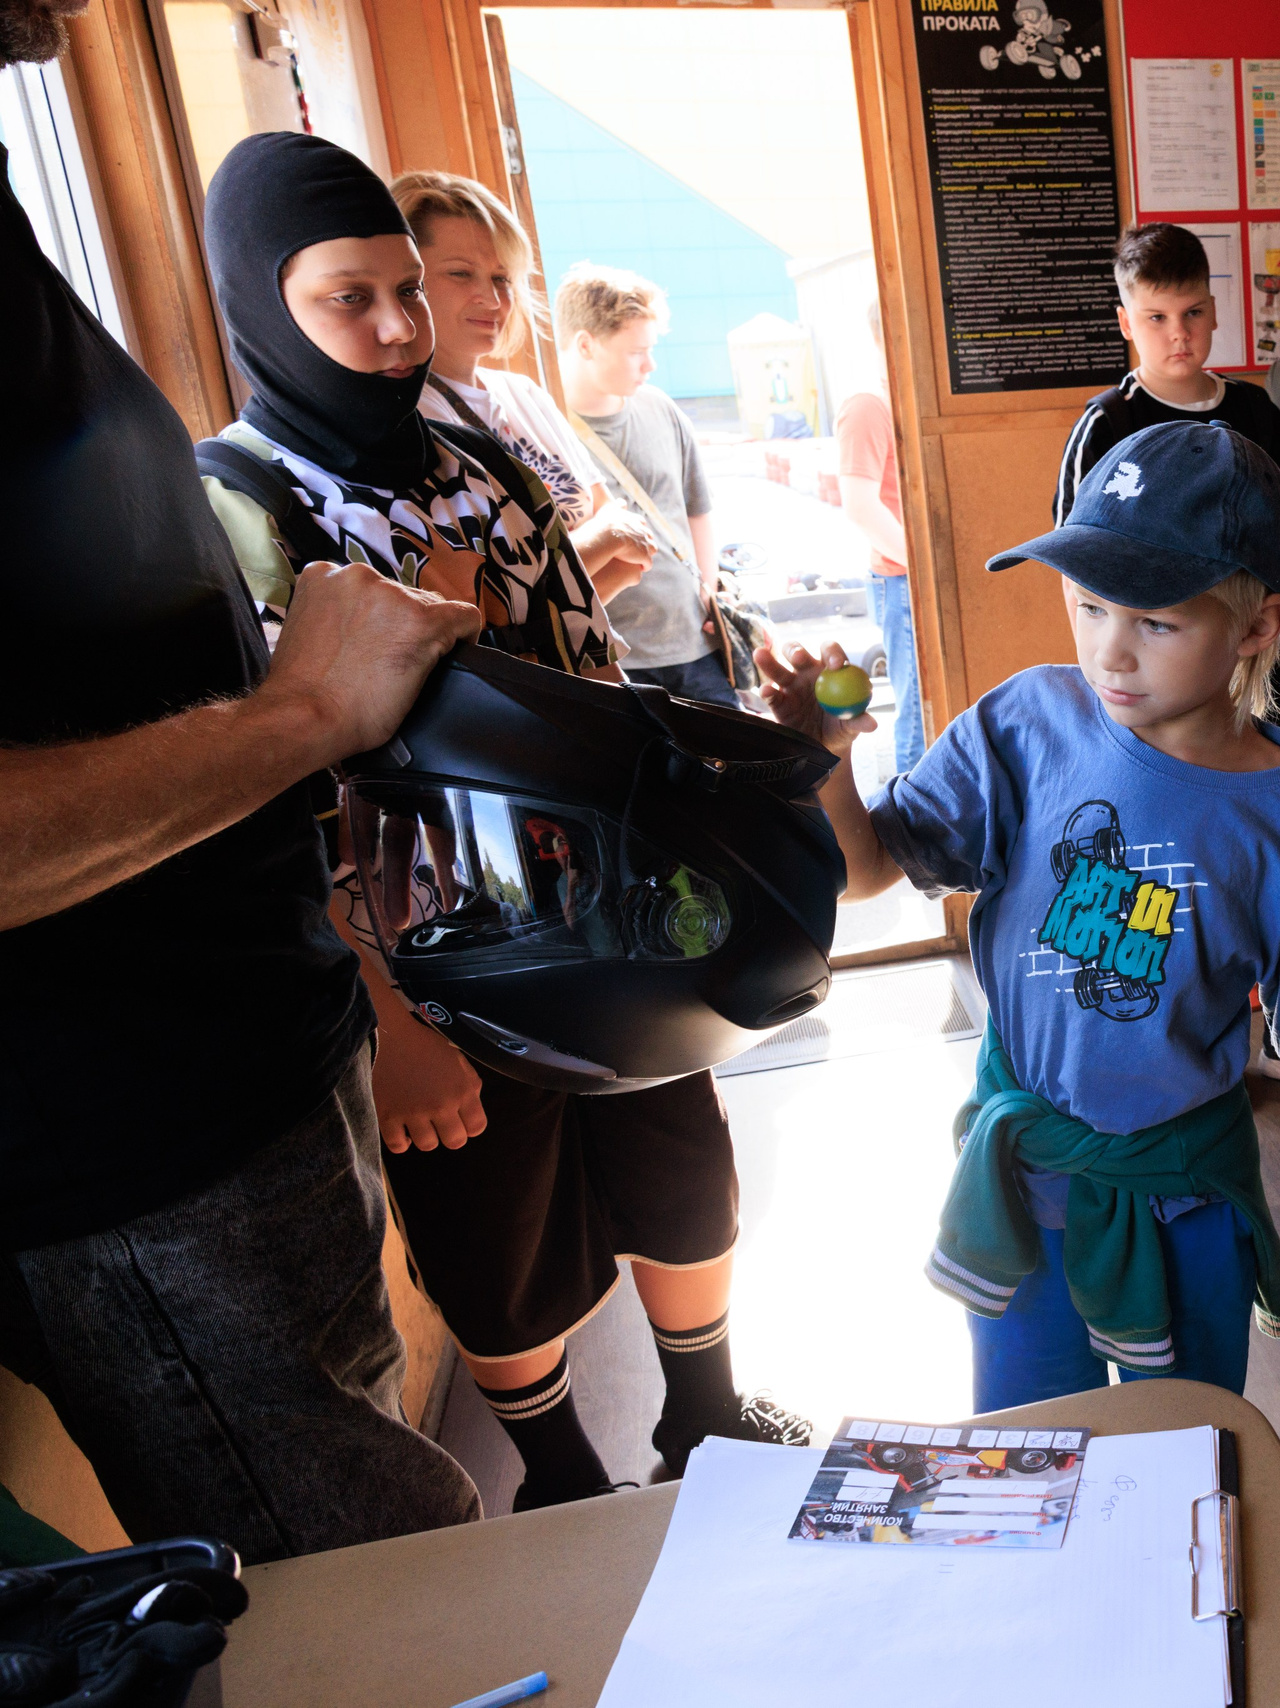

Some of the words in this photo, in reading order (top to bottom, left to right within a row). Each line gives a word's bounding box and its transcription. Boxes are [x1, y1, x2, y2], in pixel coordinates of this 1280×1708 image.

[920, 0, 999, 12] ПРАВИЛА
[922, 16, 1000, 31] ПРОКАТА
[856, 1424, 868, 1435] 8
[884, 1427, 896, 1438] 7
[913, 1429, 924, 1440] 6
[940, 1431, 952, 1443] 5
[978, 1433, 990, 1444] 4
[1005, 1434, 1017, 1444] 3
[830, 1502, 888, 1514] ЗАНЯТИЙ:
[824, 1513, 903, 1526] КОЛИЧЕСТВО
